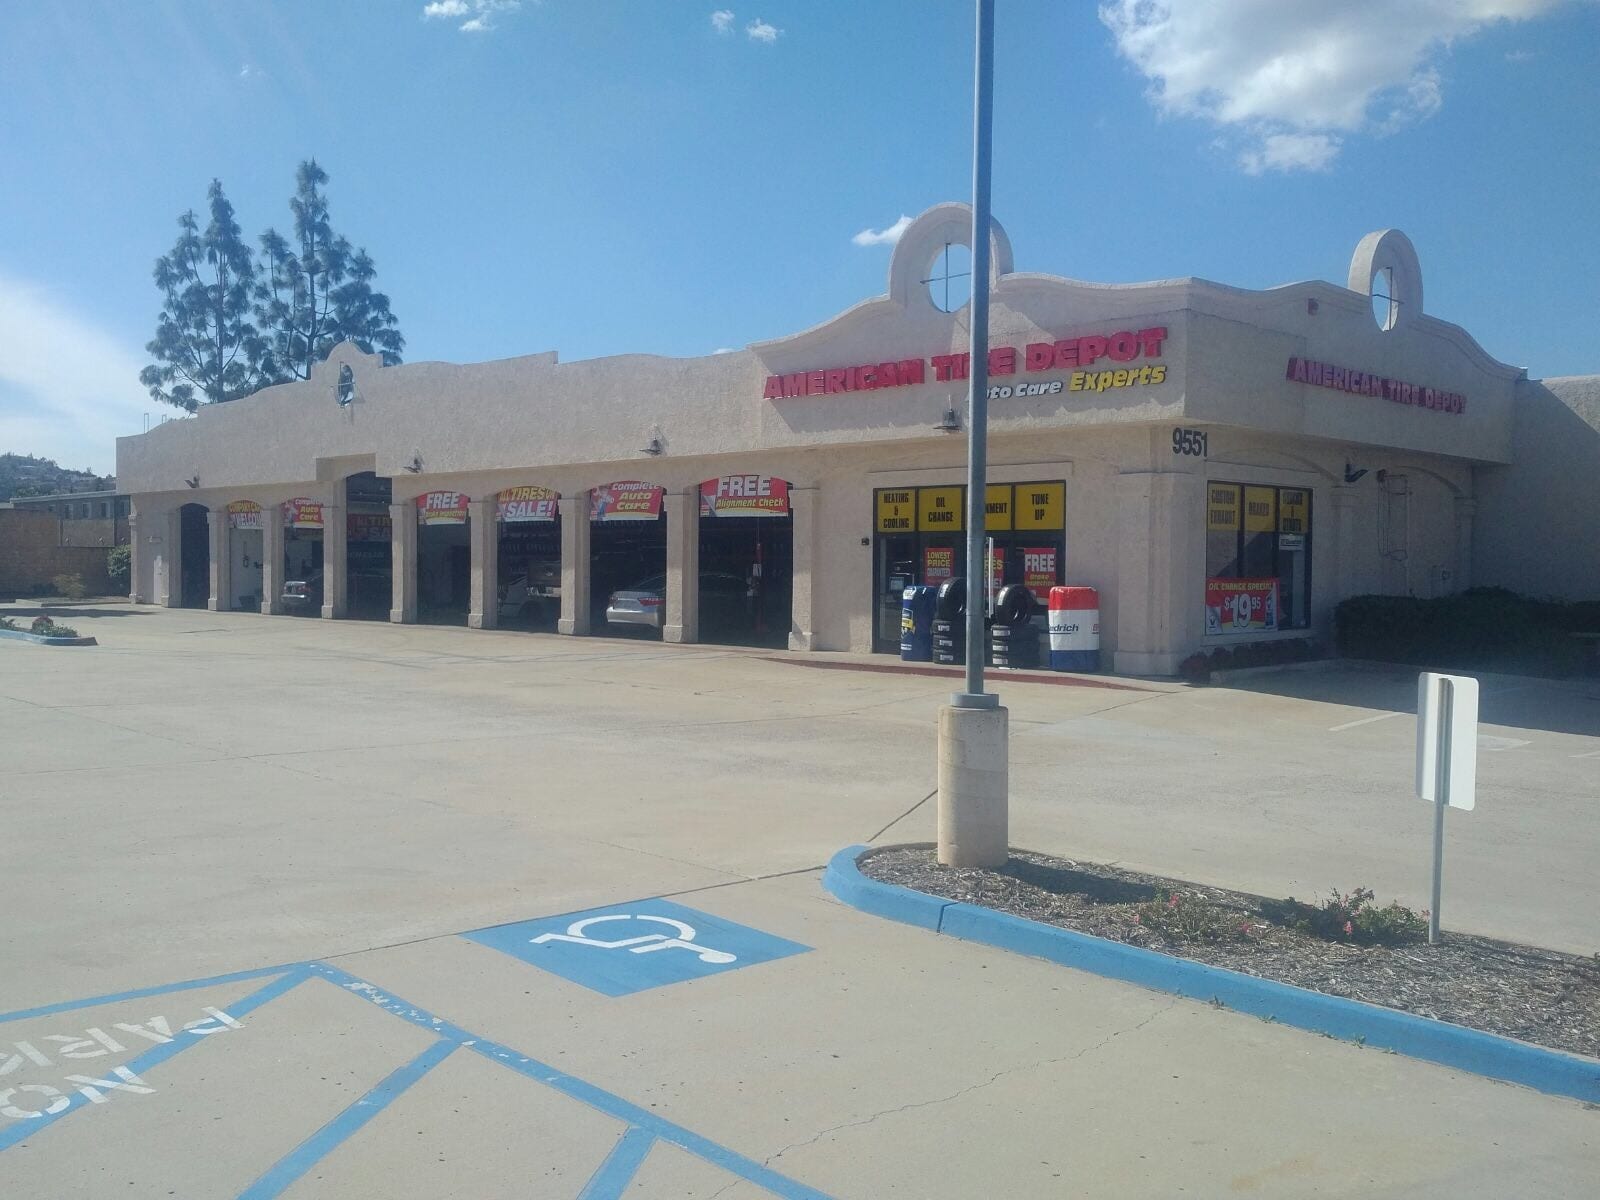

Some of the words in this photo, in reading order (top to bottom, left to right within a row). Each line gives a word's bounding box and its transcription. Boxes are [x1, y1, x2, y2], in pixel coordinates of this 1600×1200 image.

[763, 357, 925, 400] AMERICAN
[931, 347, 1016, 382] TIE
[1026, 326, 1168, 372] DEPOT
[1015, 380, 1063, 398] Care
[1069, 364, 1168, 393] Experts
[1286, 356, 1384, 398] AMERICAN
[1386, 378, 1420, 405] TIRE
[1424, 388, 1467, 415] DEPOT
[1172, 427, 1208, 457] 9551
[716, 477, 772, 496] FREE
[426, 492, 460, 509] FREE
[510, 487, 545, 501] TIRES
[883, 492, 909, 504] HEATING
[1031, 493, 1049, 505] TUNE
[506, 500, 553, 517] SALE!
[715, 497, 757, 508] Alignment
[758, 497, 785, 508] Check
[935, 496, 946, 508] OIL
[985, 503, 1008, 515] NMENT
[1034, 508, 1045, 521] UP
[883, 517, 910, 529] COOLING
[928, 511, 954, 523] CHANGE
[927, 551, 950, 559] LOWEST
[927, 559, 951, 567] PRICE
[1024, 553, 1055, 573] FREE
[0, 1065, 157, 1119] NO
